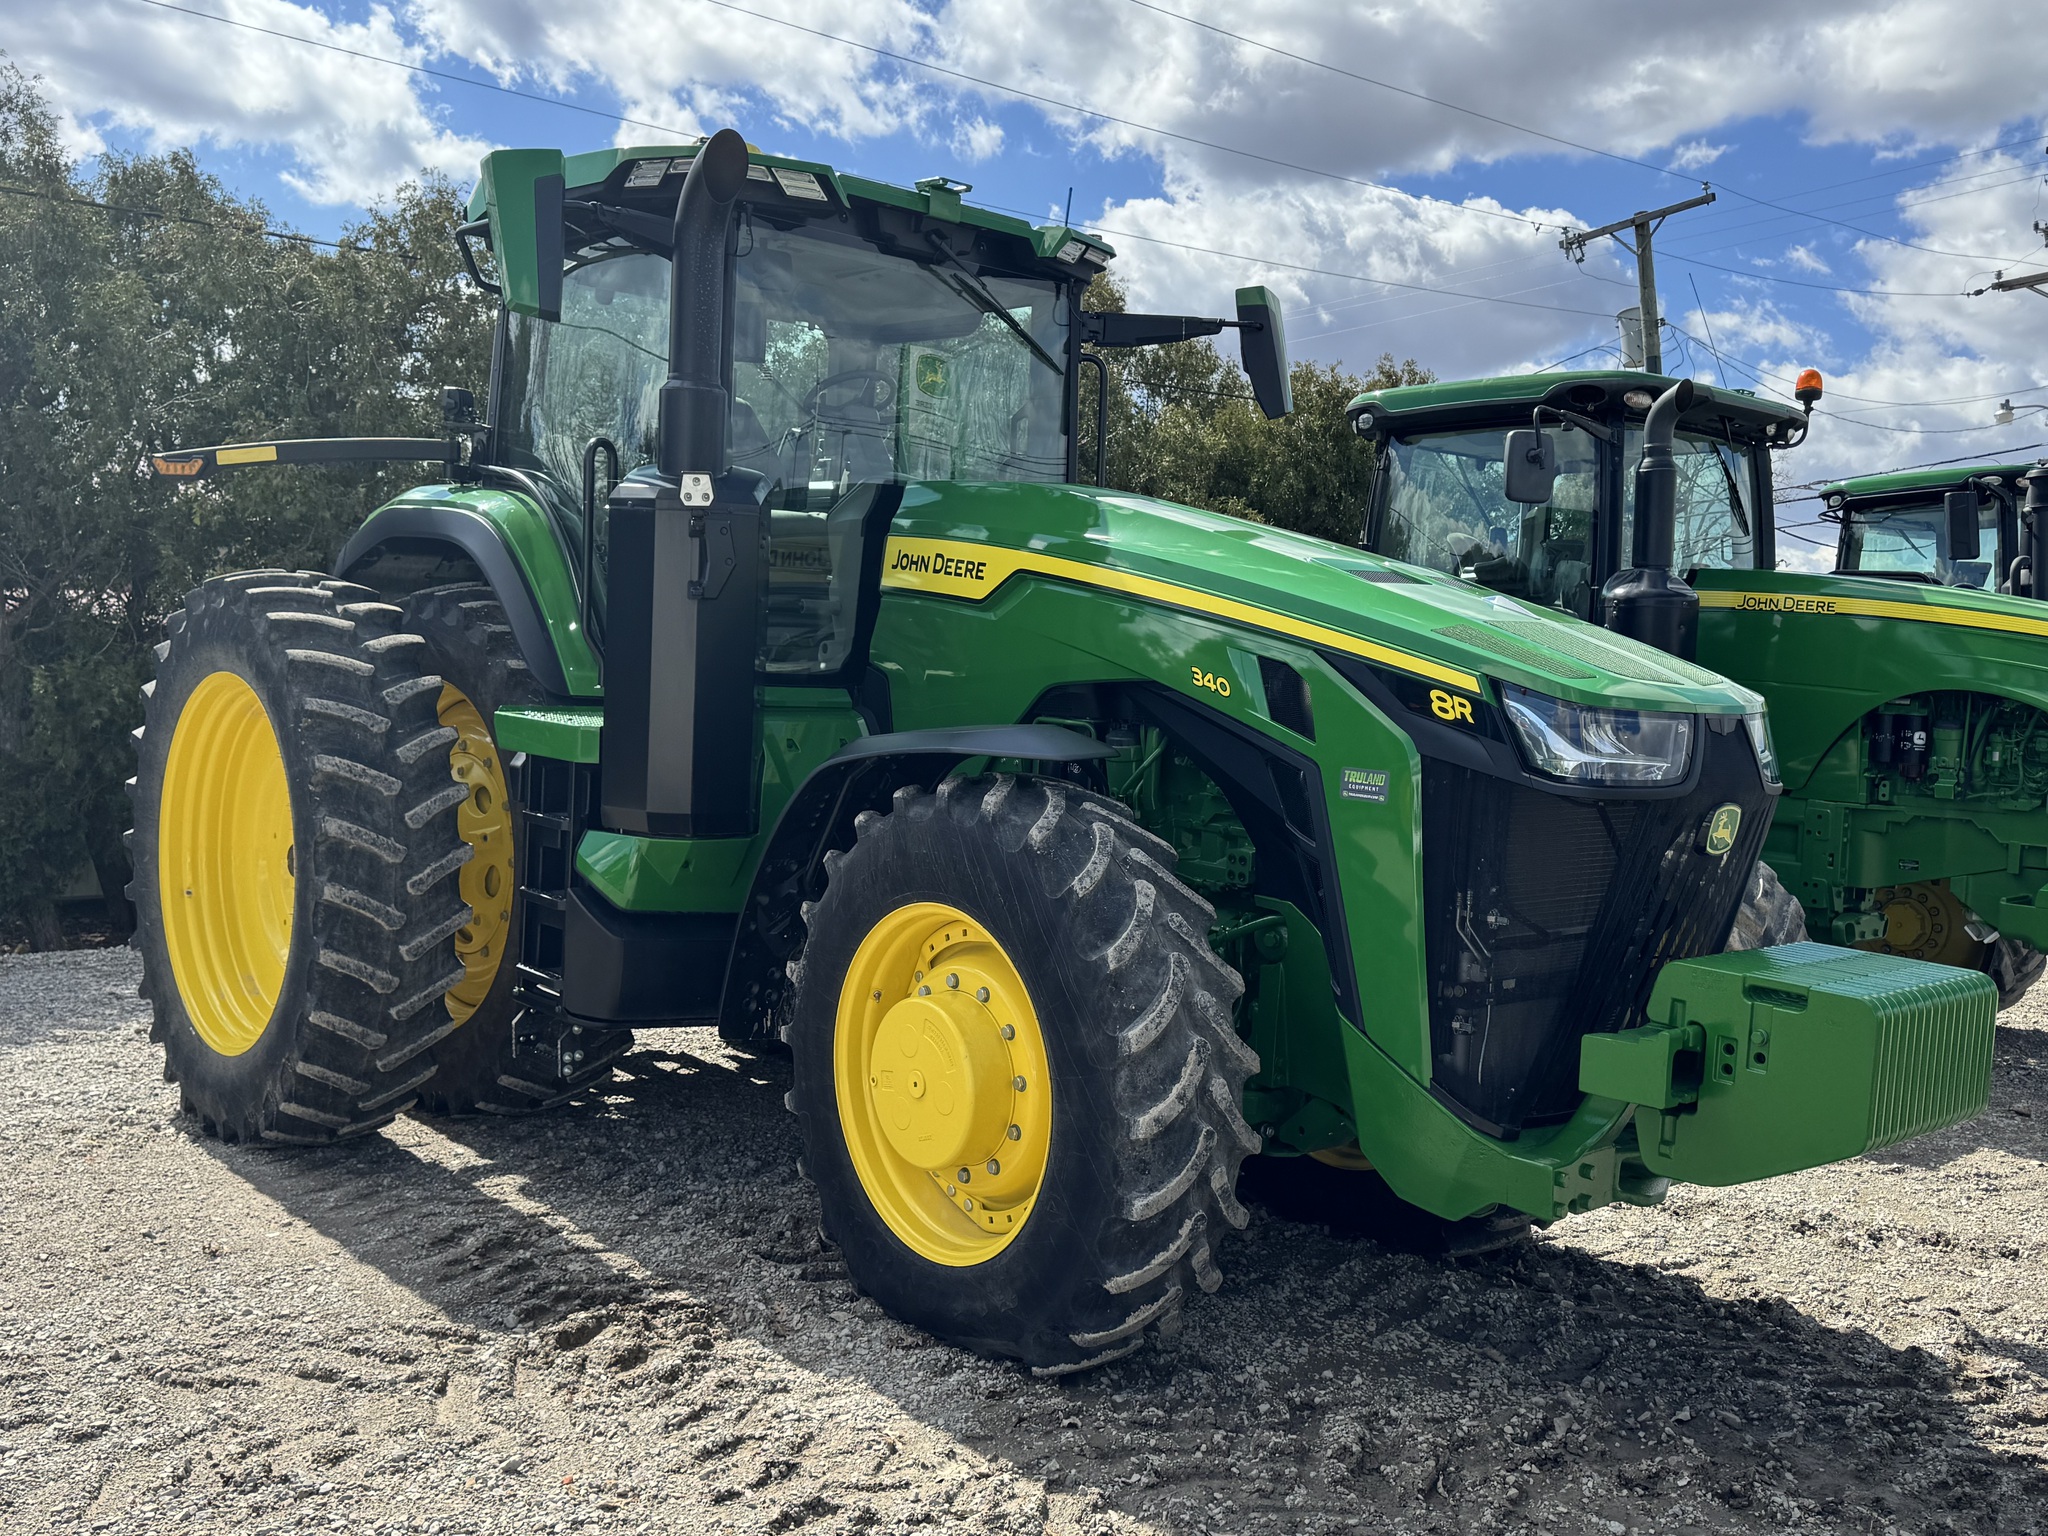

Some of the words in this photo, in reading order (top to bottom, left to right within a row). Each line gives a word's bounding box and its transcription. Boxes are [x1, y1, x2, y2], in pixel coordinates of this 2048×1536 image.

[891, 549, 931, 573] JOHN
[932, 552, 987, 581] DEERE
[1737, 594, 1780, 609] JOHN
[1783, 597, 1837, 612] DEERE
[1191, 666, 1231, 697] 340
[1429, 689, 1475, 724] 8R
[1344, 770, 1386, 786] TRULAND
[1348, 783, 1379, 792] EQUIPMENT
